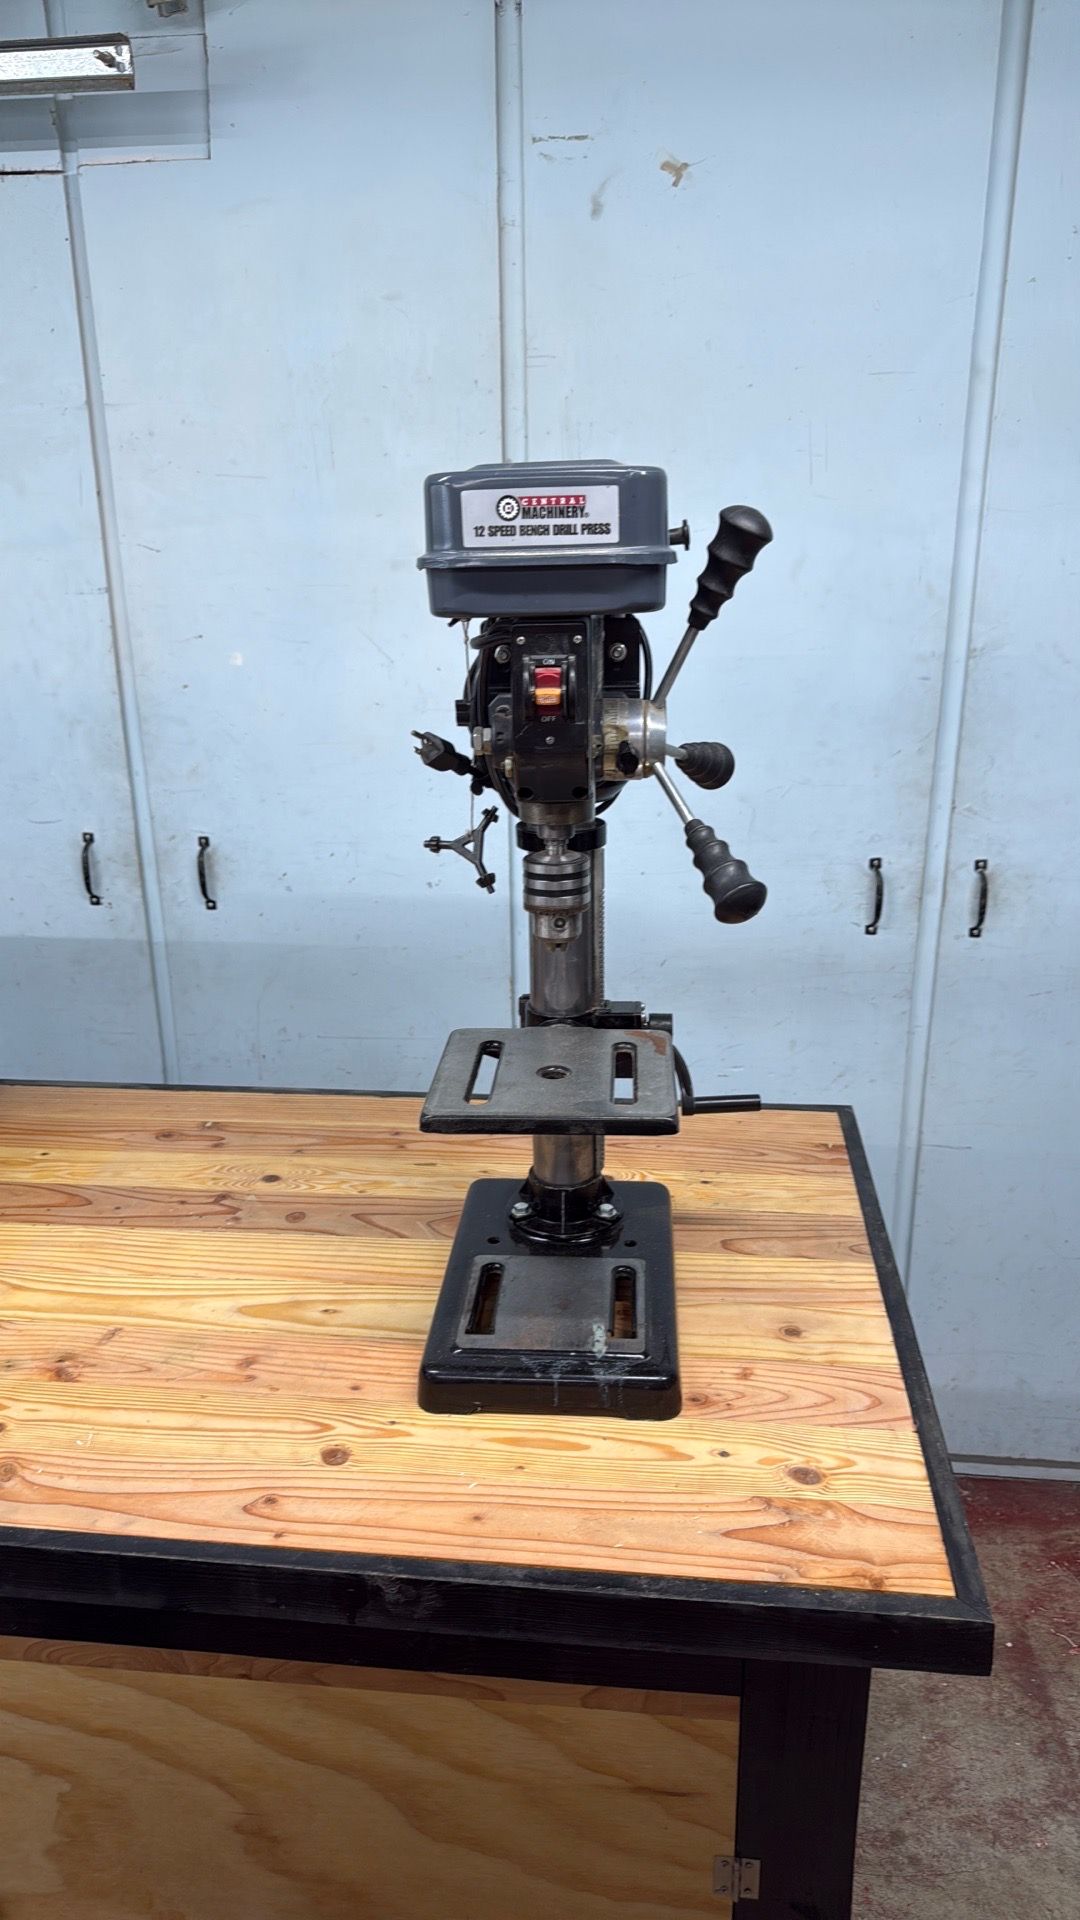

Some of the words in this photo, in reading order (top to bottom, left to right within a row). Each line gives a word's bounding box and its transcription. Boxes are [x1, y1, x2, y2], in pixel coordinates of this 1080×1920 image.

[522, 497, 585, 505] CENTRAL
[473, 526, 485, 537] 12
[487, 525, 516, 537] SPEED
[519, 524, 550, 536] BENCH
[553, 524, 578, 536] DRILL
[580, 523, 611, 535] PRESS
